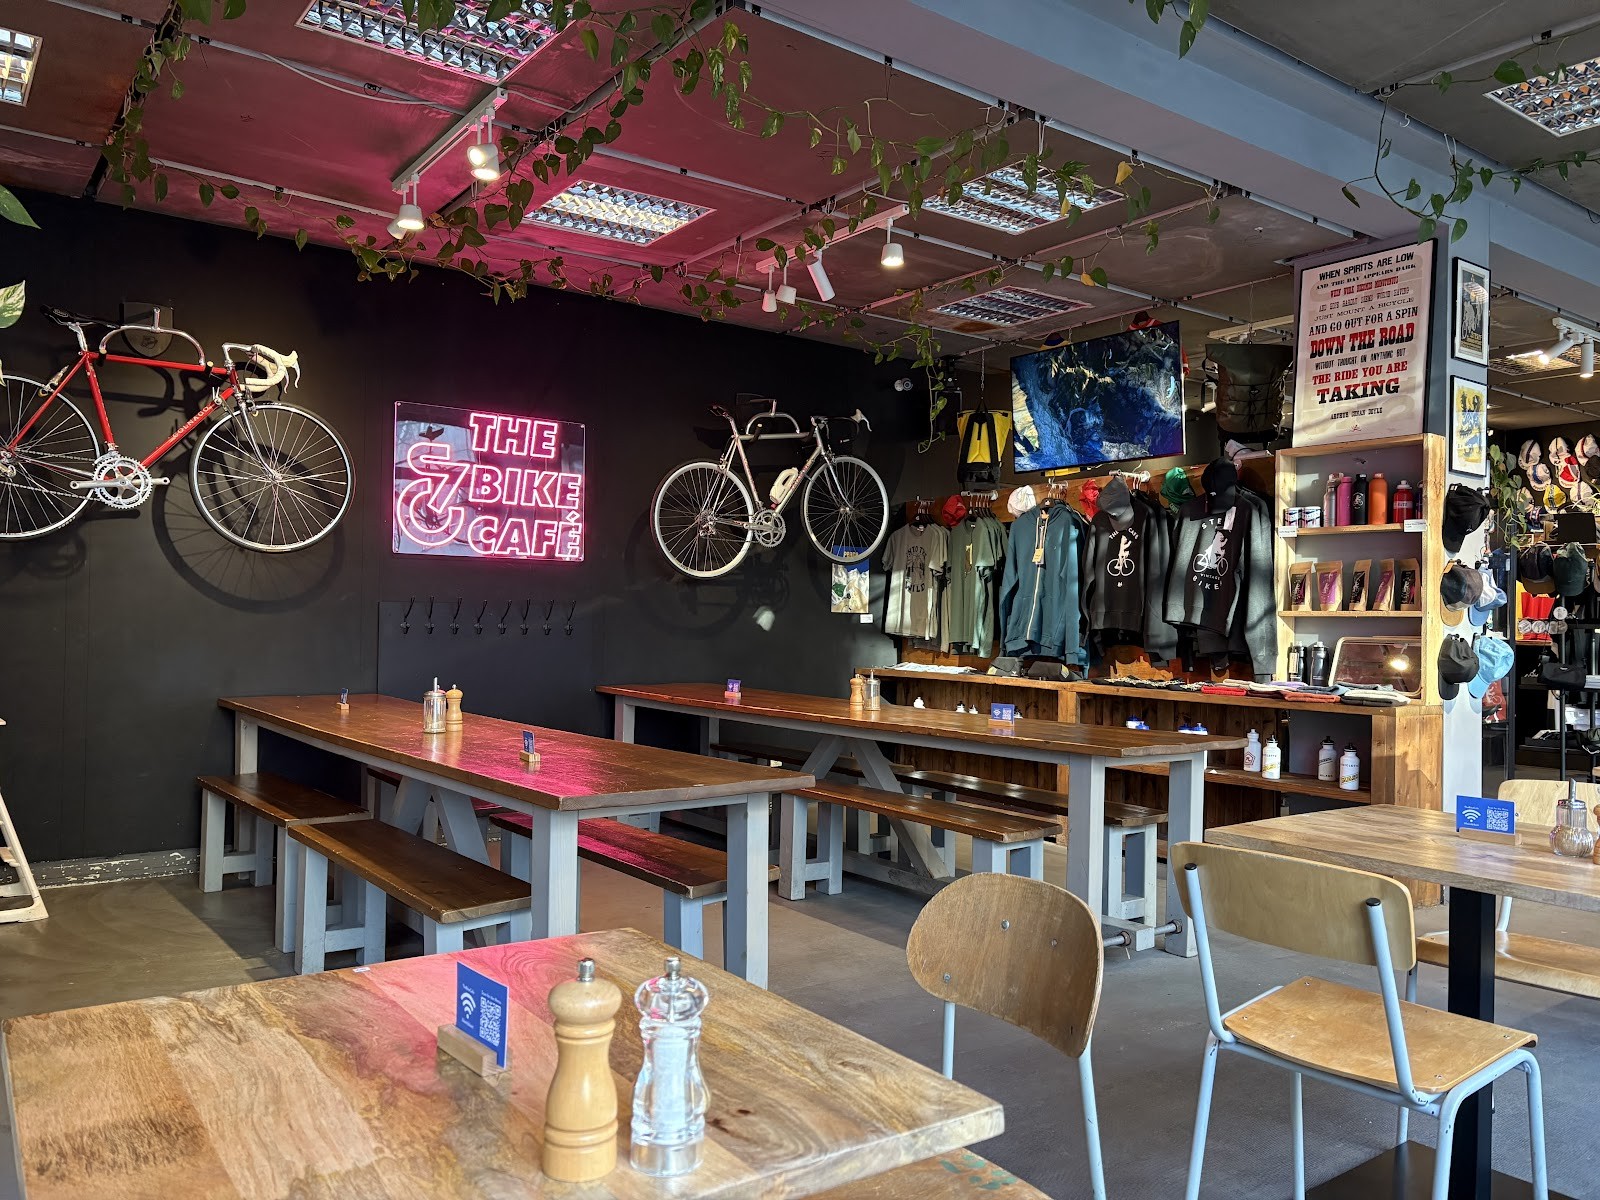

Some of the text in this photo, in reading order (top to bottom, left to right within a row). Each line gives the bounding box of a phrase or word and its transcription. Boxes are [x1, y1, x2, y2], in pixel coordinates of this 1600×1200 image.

[1319, 252, 1413, 280] WHEN SPIRITS ARE LOW
[1363, 268, 1392, 279] APPEARS
[1395, 263, 1415, 272] DARK
[1337, 307, 1365, 316] MOUNT
[1378, 297, 1414, 308] BICYCLE
[1308, 306, 1418, 336] AND GO OUT FOR A SPIN
[1310, 322, 1414, 359] DOWN THE ROAD
[1312, 361, 1407, 385] THE RIDE YOU ARE
[1315, 360, 1334, 370] WITHOUT
[1370, 350, 1393, 361] ANYTHING
[1316, 377, 1400, 404] TAKING
[470, 412, 558, 458] THE
[468, 465, 581, 509] BIKE
